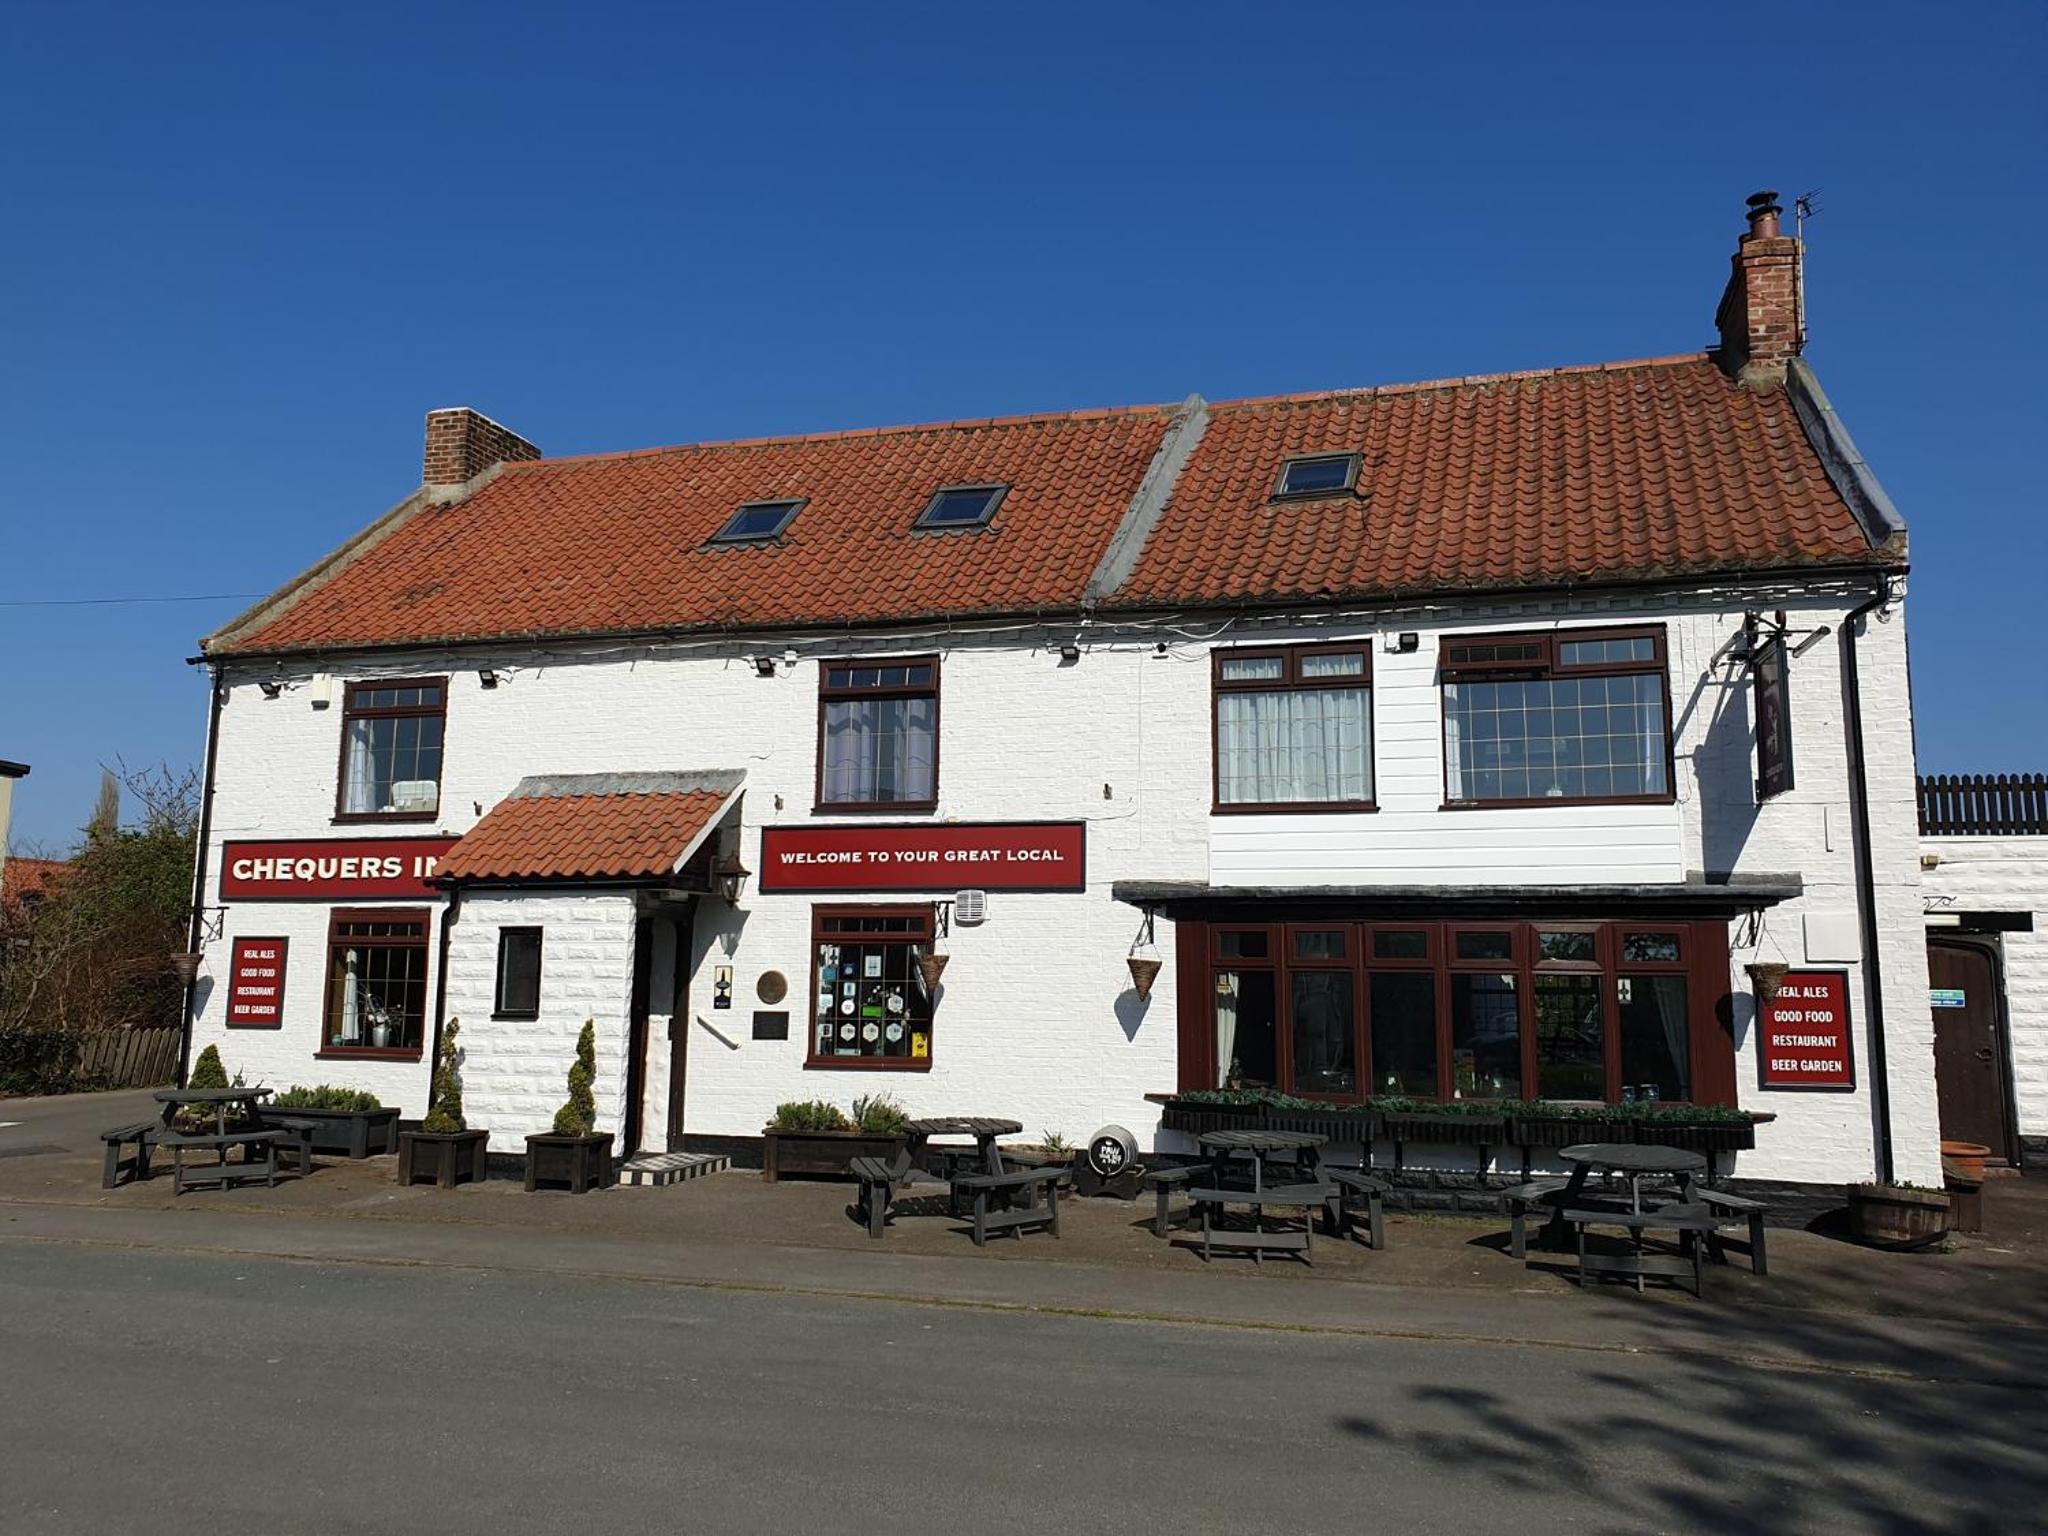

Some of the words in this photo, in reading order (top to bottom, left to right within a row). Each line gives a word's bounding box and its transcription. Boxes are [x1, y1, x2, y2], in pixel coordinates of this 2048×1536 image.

[780, 852, 862, 864] WELCOME
[868, 851, 890, 863] TO
[894, 851, 939, 863] YOUR
[944, 850, 1001, 862] GREAT
[1007, 849, 1064, 861] LOCAL
[232, 857, 403, 882] CHEQUERS
[244, 949, 259, 959] REAL
[260, 949, 275, 960] ALES
[240, 968, 258, 977] GOOD
[258, 968, 275, 978] FOOD
[237, 986, 276, 997] RESTAURANT
[1803, 986, 1829, 998] ALES
[234, 1004, 250, 1015] BEER
[251, 1004, 276, 1015] GARDEN
[1774, 1010, 1803, 1022] GOOD
[1805, 1011, 1833, 1023] FOOD
[1772, 1034, 1838, 1047] RESTAURANT
[1771, 1059, 1798, 1071] BEER
[1800, 1060, 1842, 1072] GARDEN
